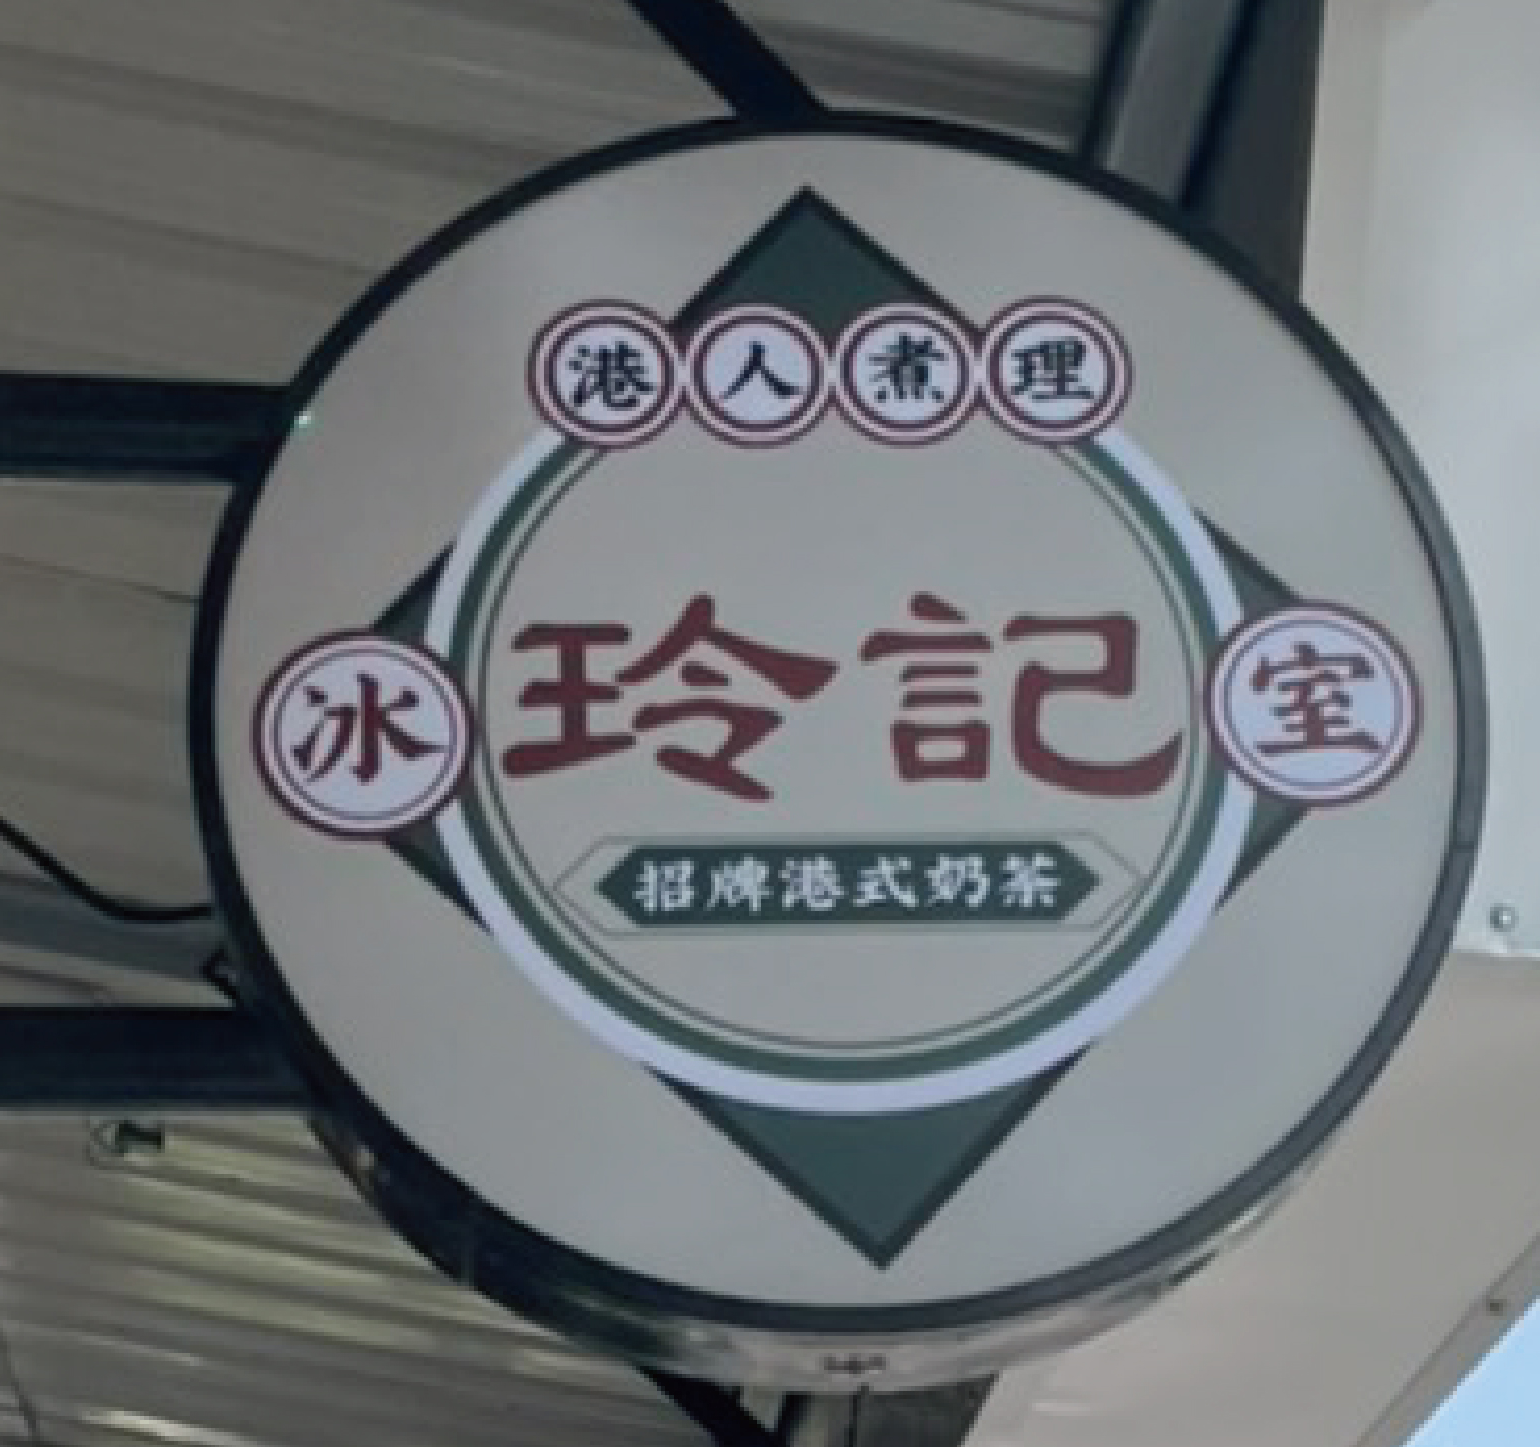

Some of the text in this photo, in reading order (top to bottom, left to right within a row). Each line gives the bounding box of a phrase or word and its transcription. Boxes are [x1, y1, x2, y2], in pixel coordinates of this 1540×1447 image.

[567, 335, 1097, 409] 港人煮理
[291, 671, 447, 786] 冰
[501, 593, 1186, 802] 玲記
[1247, 640, 1384, 760] 室
[631, 850, 1062, 916] 招牌港式奶茶
